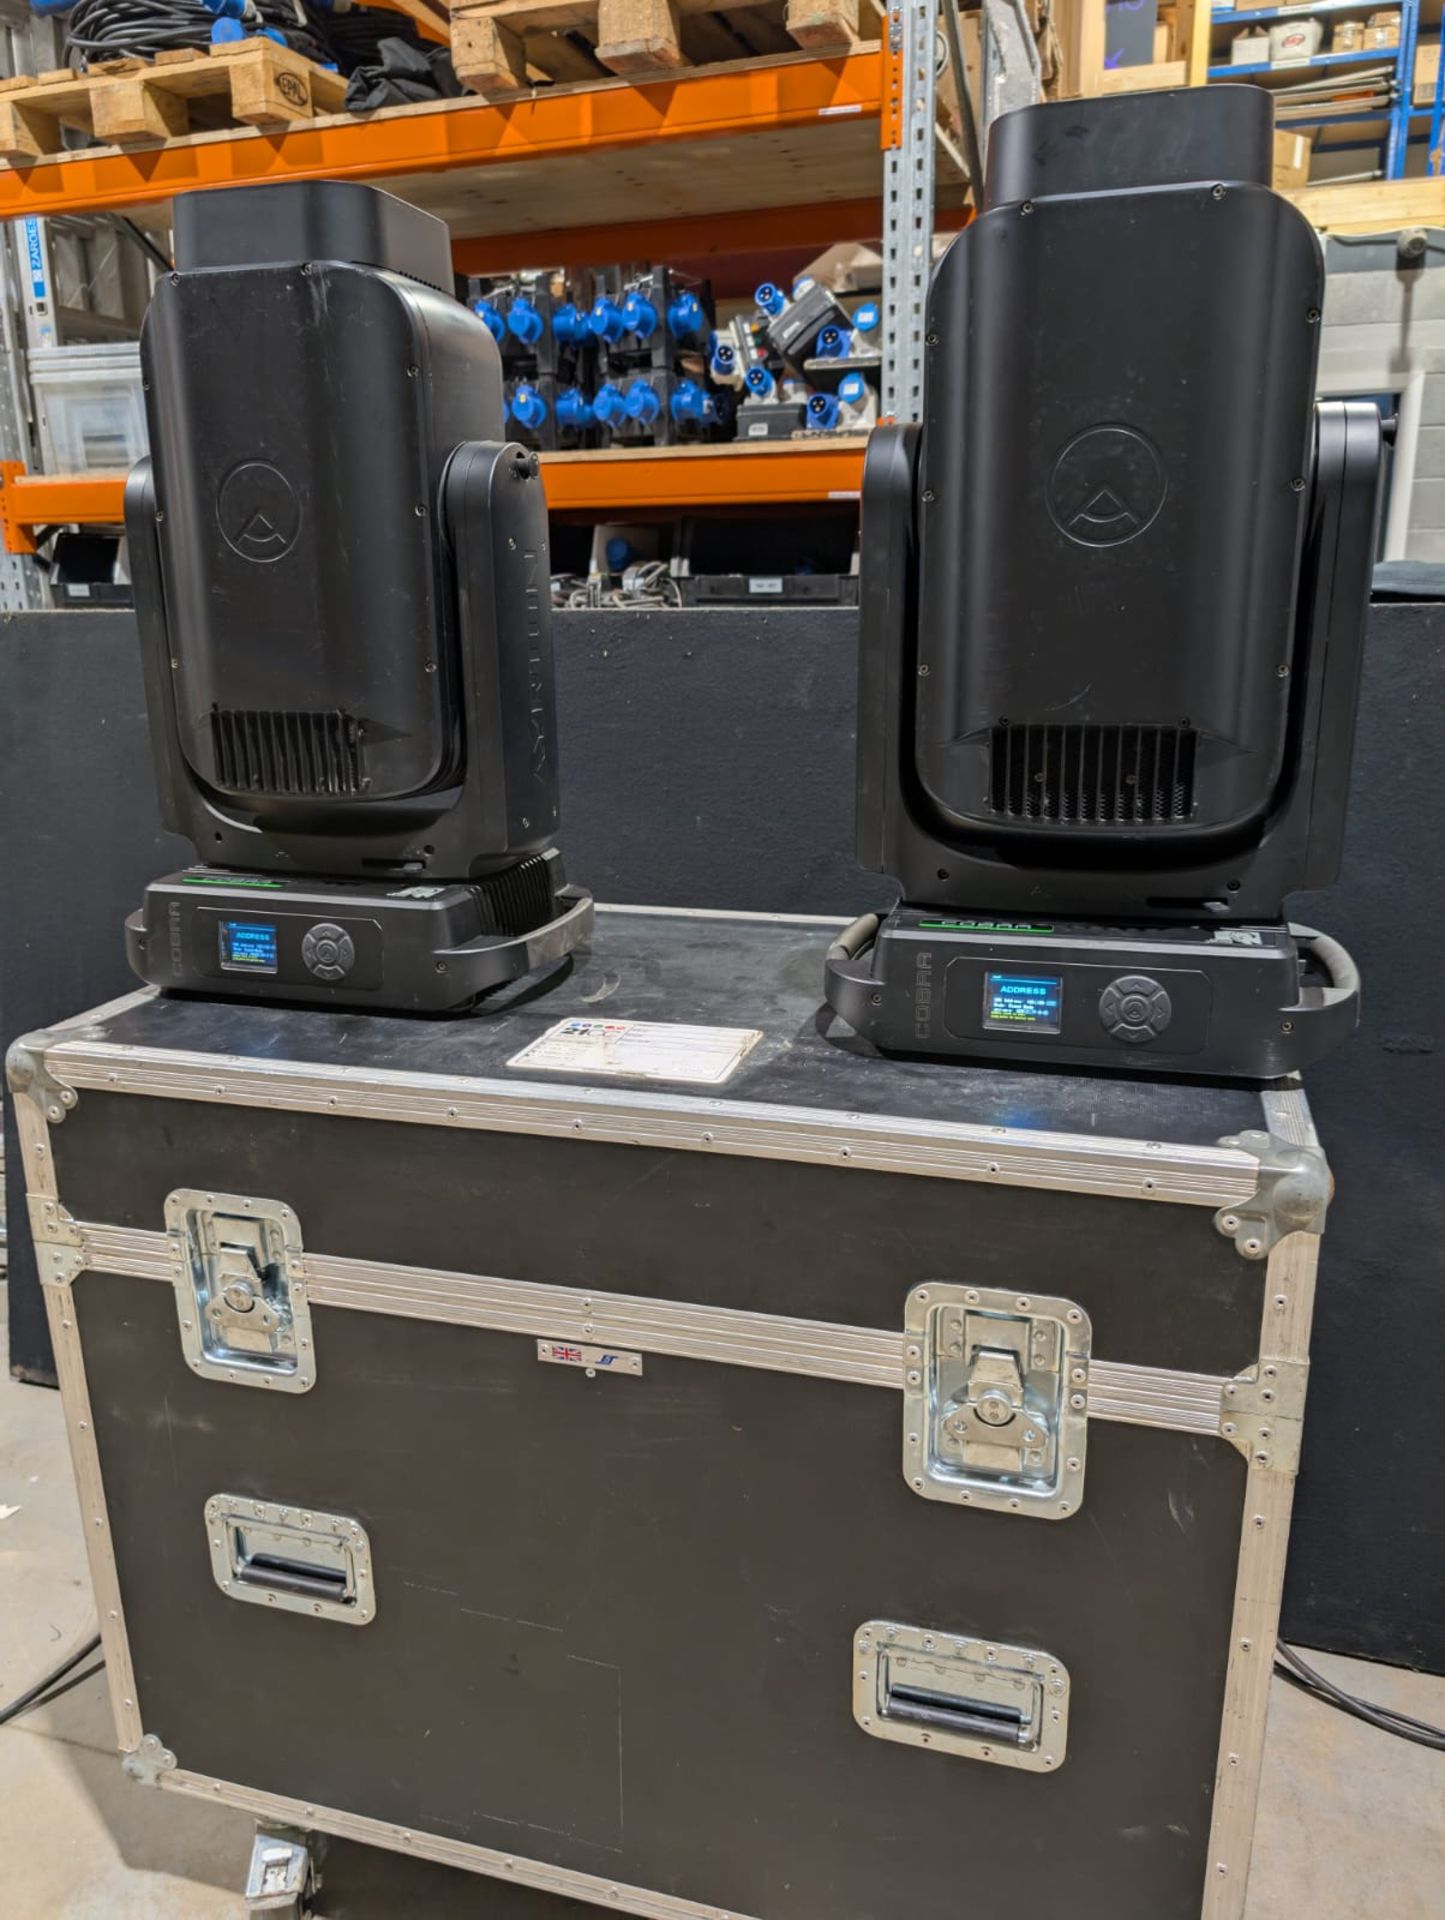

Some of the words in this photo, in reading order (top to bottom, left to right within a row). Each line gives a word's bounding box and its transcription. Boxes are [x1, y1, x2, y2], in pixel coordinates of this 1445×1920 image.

[169, 901, 182, 976] COBRA
[917, 952, 932, 1038] COBRA
[1000, 985, 1046, 995] ADDRESS
